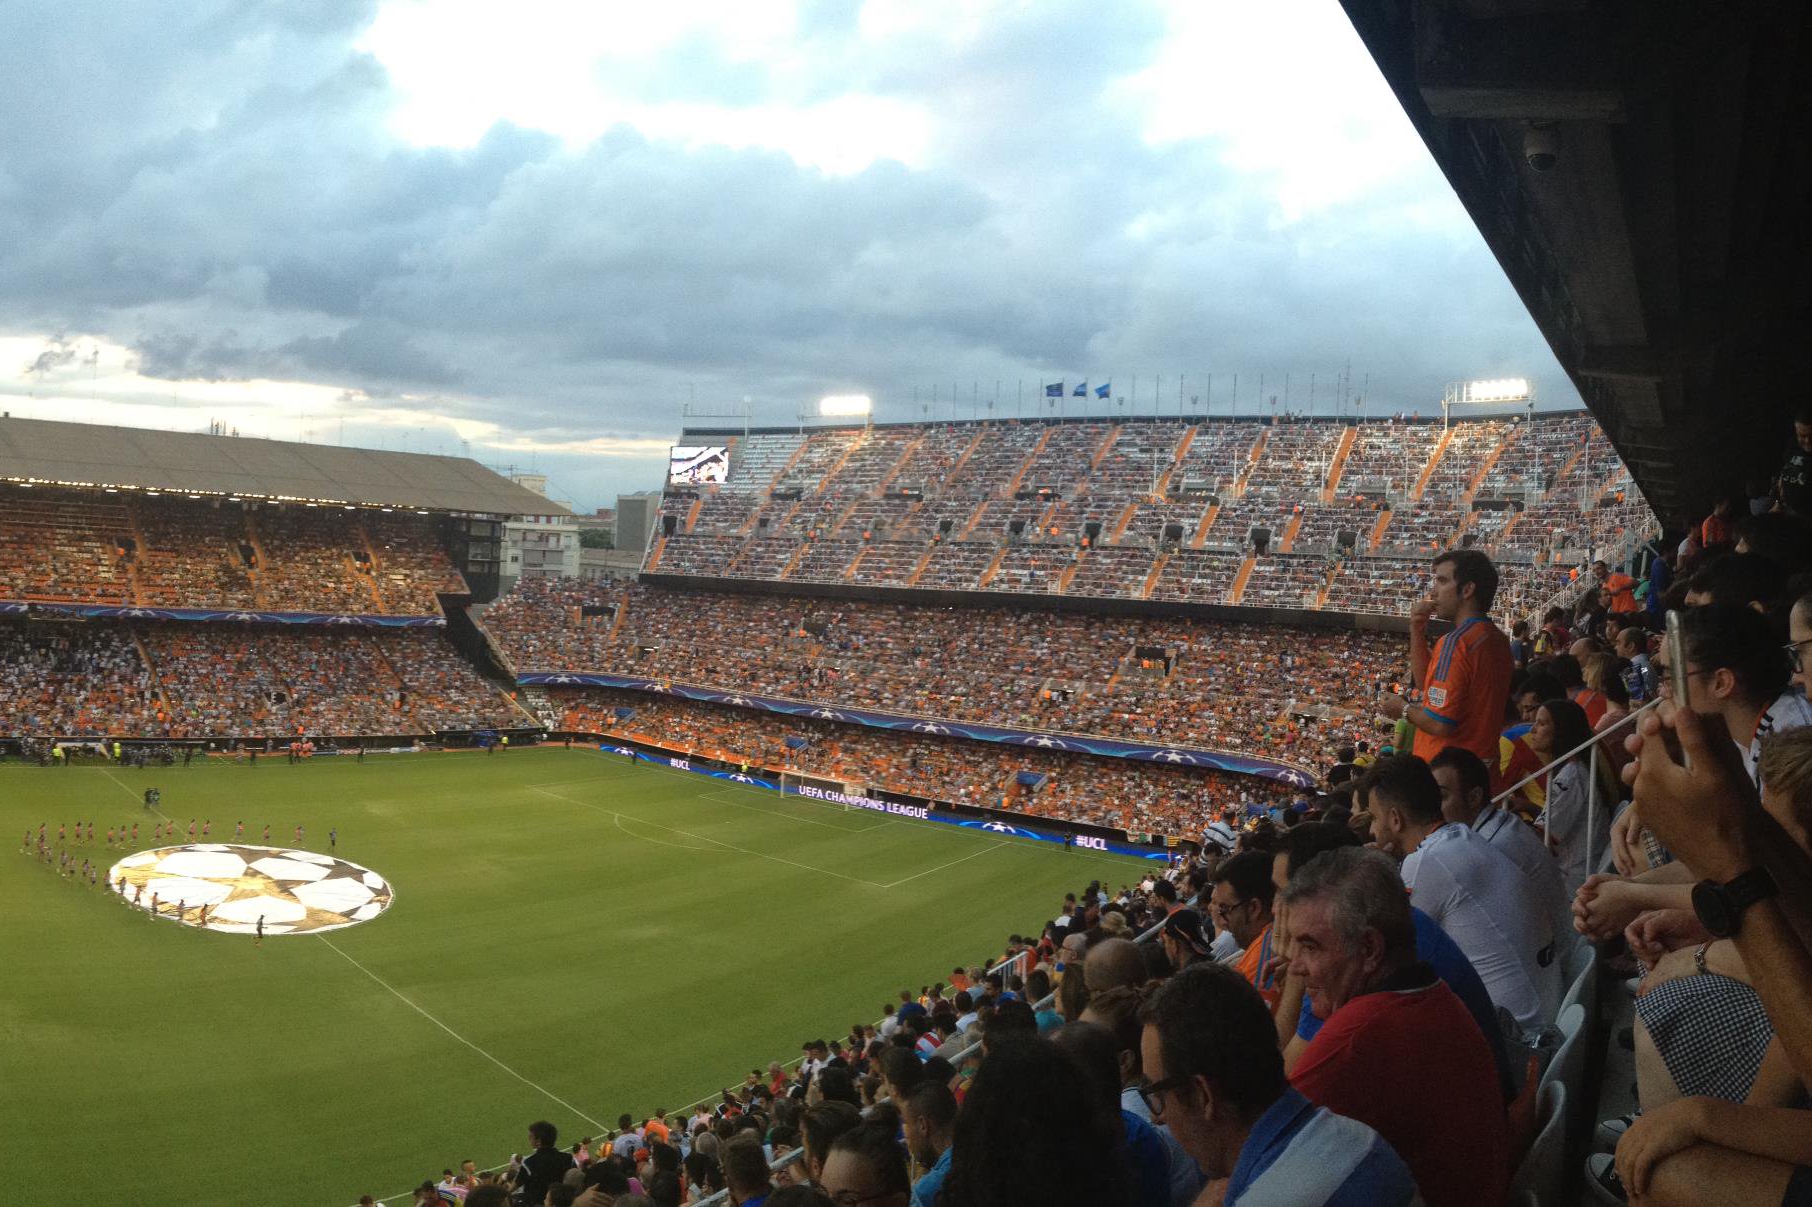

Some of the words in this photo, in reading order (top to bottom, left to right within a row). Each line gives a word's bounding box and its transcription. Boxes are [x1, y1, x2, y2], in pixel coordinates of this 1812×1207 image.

[670, 757, 691, 771] #UCL
[798, 785, 824, 799] UEFA
[825, 790, 885, 811] CHAMPIONS
[887, 801, 929, 819] LEAGUE
[1075, 834, 1109, 851] #UCL
